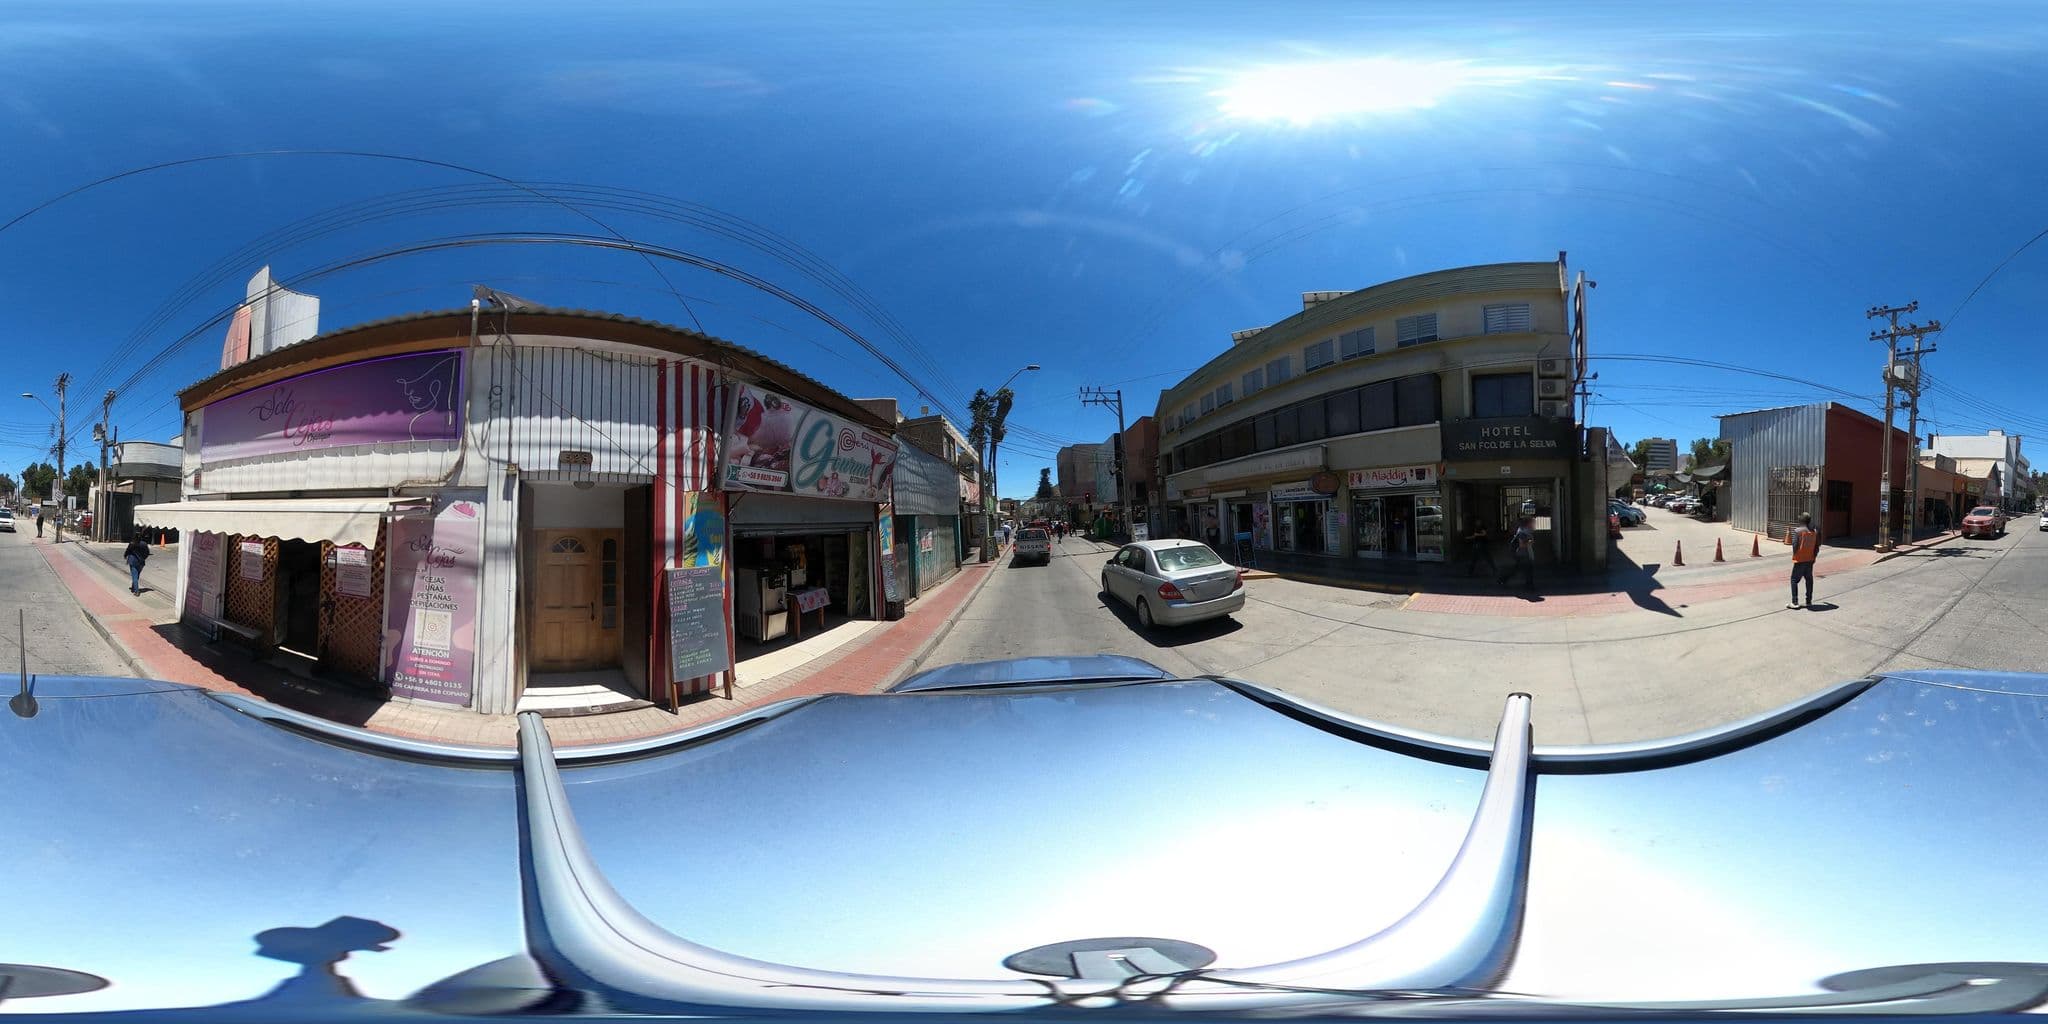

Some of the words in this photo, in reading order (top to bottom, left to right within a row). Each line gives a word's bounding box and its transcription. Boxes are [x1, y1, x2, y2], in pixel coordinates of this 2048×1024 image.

[248, 386, 295, 421] Solo
[283, 402, 334, 446] Cejas
[1481, 426, 1531, 437] HOTEL
[1458, 442, 1476, 450] SAN
[1499, 441, 1511, 449] DE
[1514, 440, 1526, 448] LA
[1529, 439, 1557, 448] SELVA
[796, 418, 871, 488] Gourme
[1371, 469, 1407, 481] Aladdin
[426, 550, 456, 568] Cejas
[425, 583, 444, 592] UÑAS
[416, 592, 452, 601] PESTAÑAS
[410, 600, 458, 610] DEPILACIONES
[411, 648, 449, 658] ATENCIÓN
[403, 684, 430, 693] CARRERA
